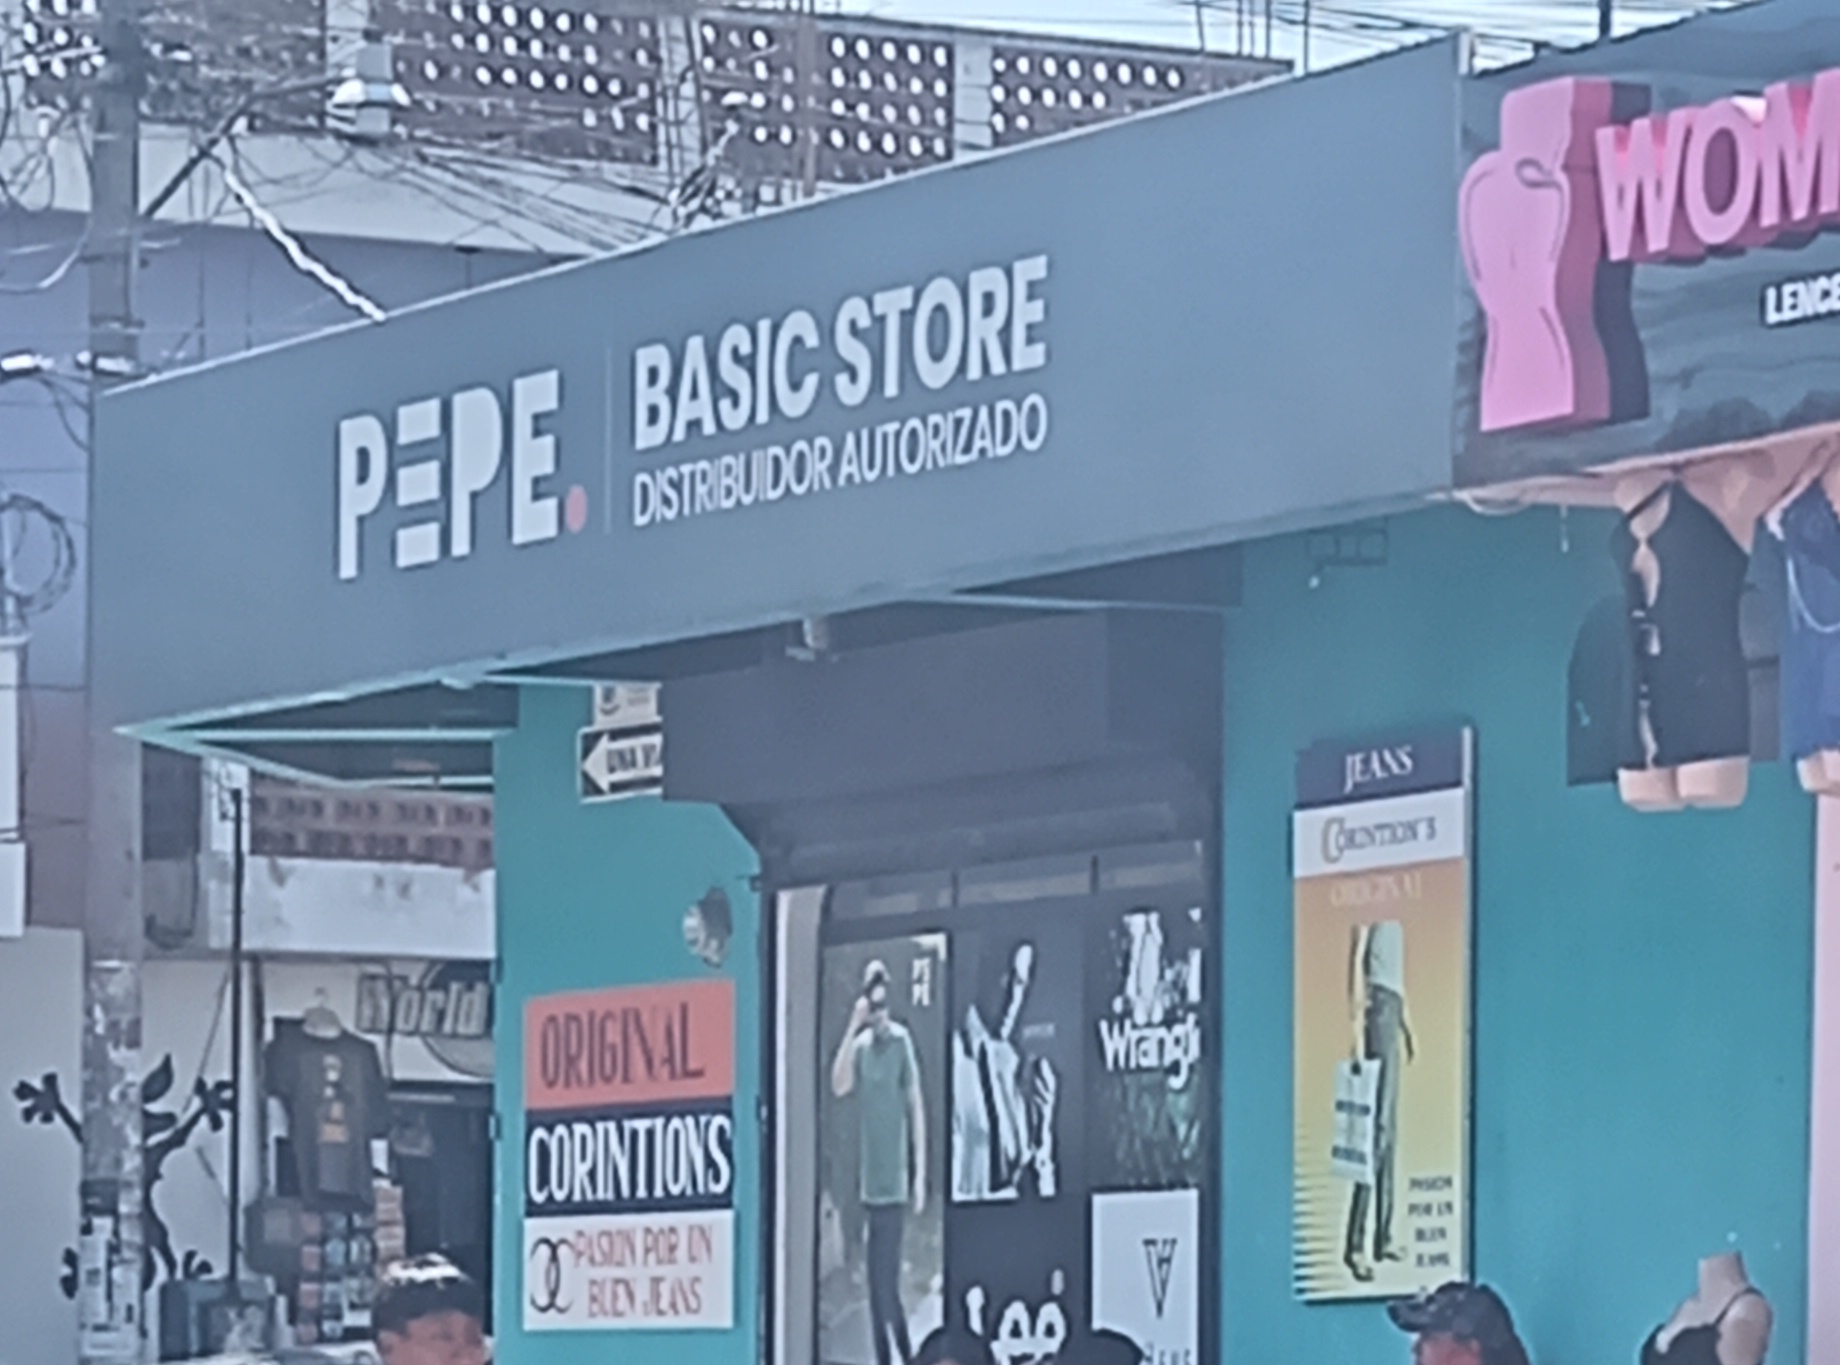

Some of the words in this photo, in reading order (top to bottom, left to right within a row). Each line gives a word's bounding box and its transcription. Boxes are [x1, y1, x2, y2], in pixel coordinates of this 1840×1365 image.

[1595, 66, 1840, 263] WOM
[634, 310, 820, 451] BASIC
[834, 254, 1048, 406] STORE
[633, 436, 832, 527] DISTRIBUIDOR
[838, 393, 1049, 487] AUTORIZADO
[1343, 744, 1415, 794] JEANS
[539, 1002, 706, 1091] ORIGINAL
[528, 1113, 732, 1205] CORINTIONS
[643, 1226, 680, 1268] POR
[688, 1223, 713, 1266] UN
[587, 1278, 637, 1320] BUEN
[643, 1275, 704, 1318] JEANS
